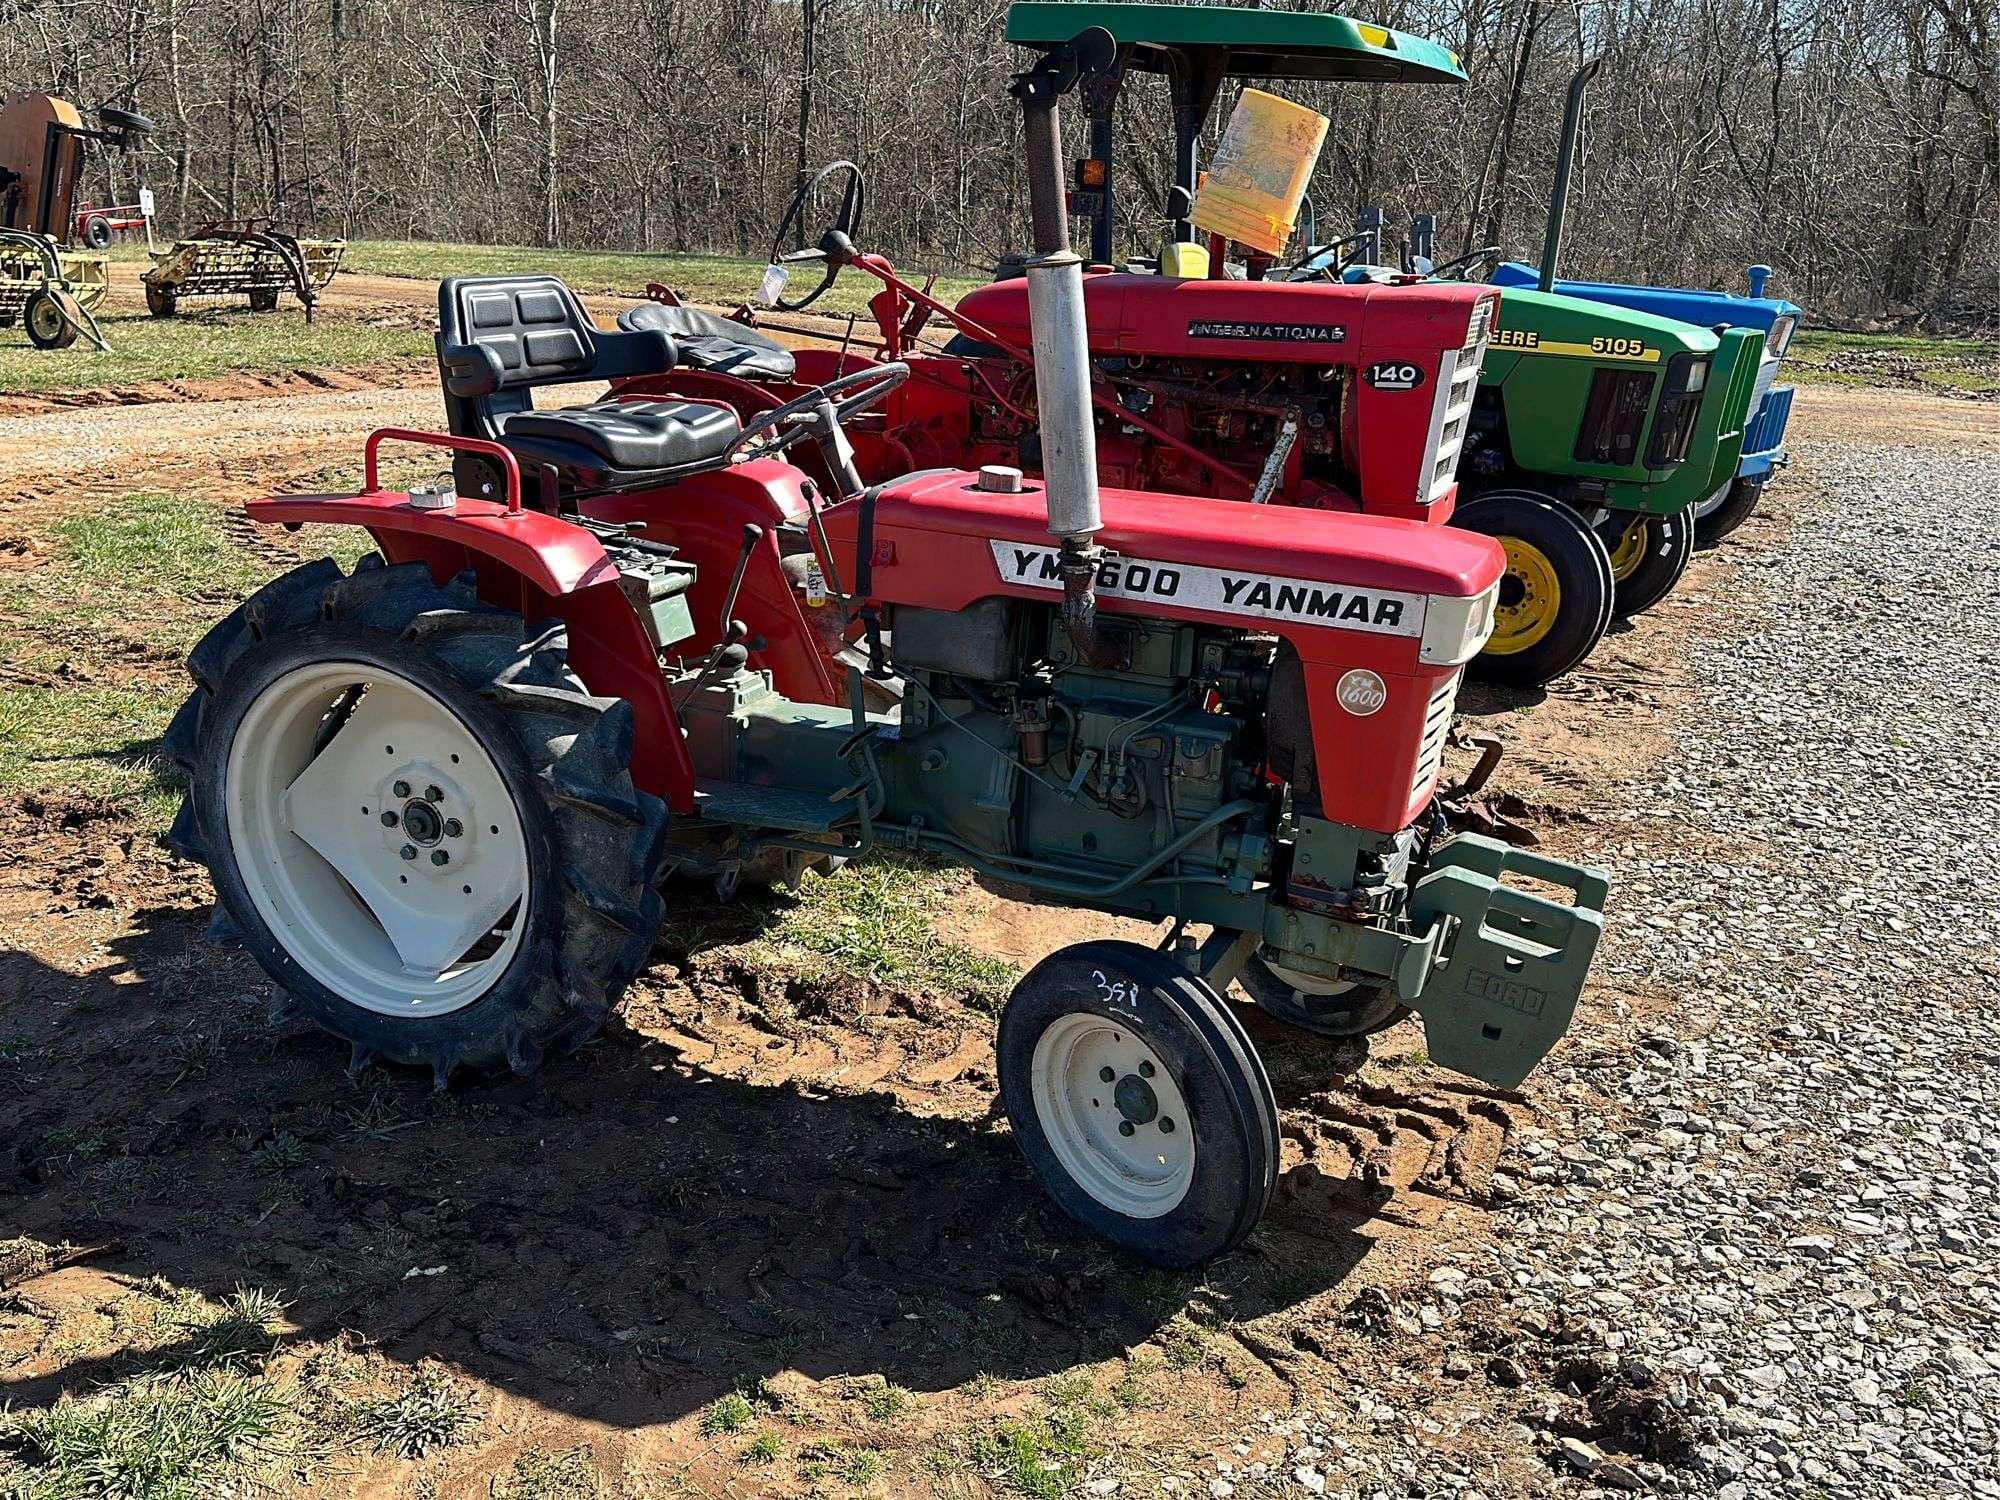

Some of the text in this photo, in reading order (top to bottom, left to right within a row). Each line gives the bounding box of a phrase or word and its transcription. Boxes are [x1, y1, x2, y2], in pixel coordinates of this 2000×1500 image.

[1190, 322, 1345, 341] INTERNATIONAL
[1488, 329, 1643, 355] EERE 5105
[1373, 365, 1416, 382] 140
[1013, 549, 1404, 627] YM600 YANMAR
[1341, 687, 1383, 708] 1600
[1463, 967, 1549, 1019] FORD
